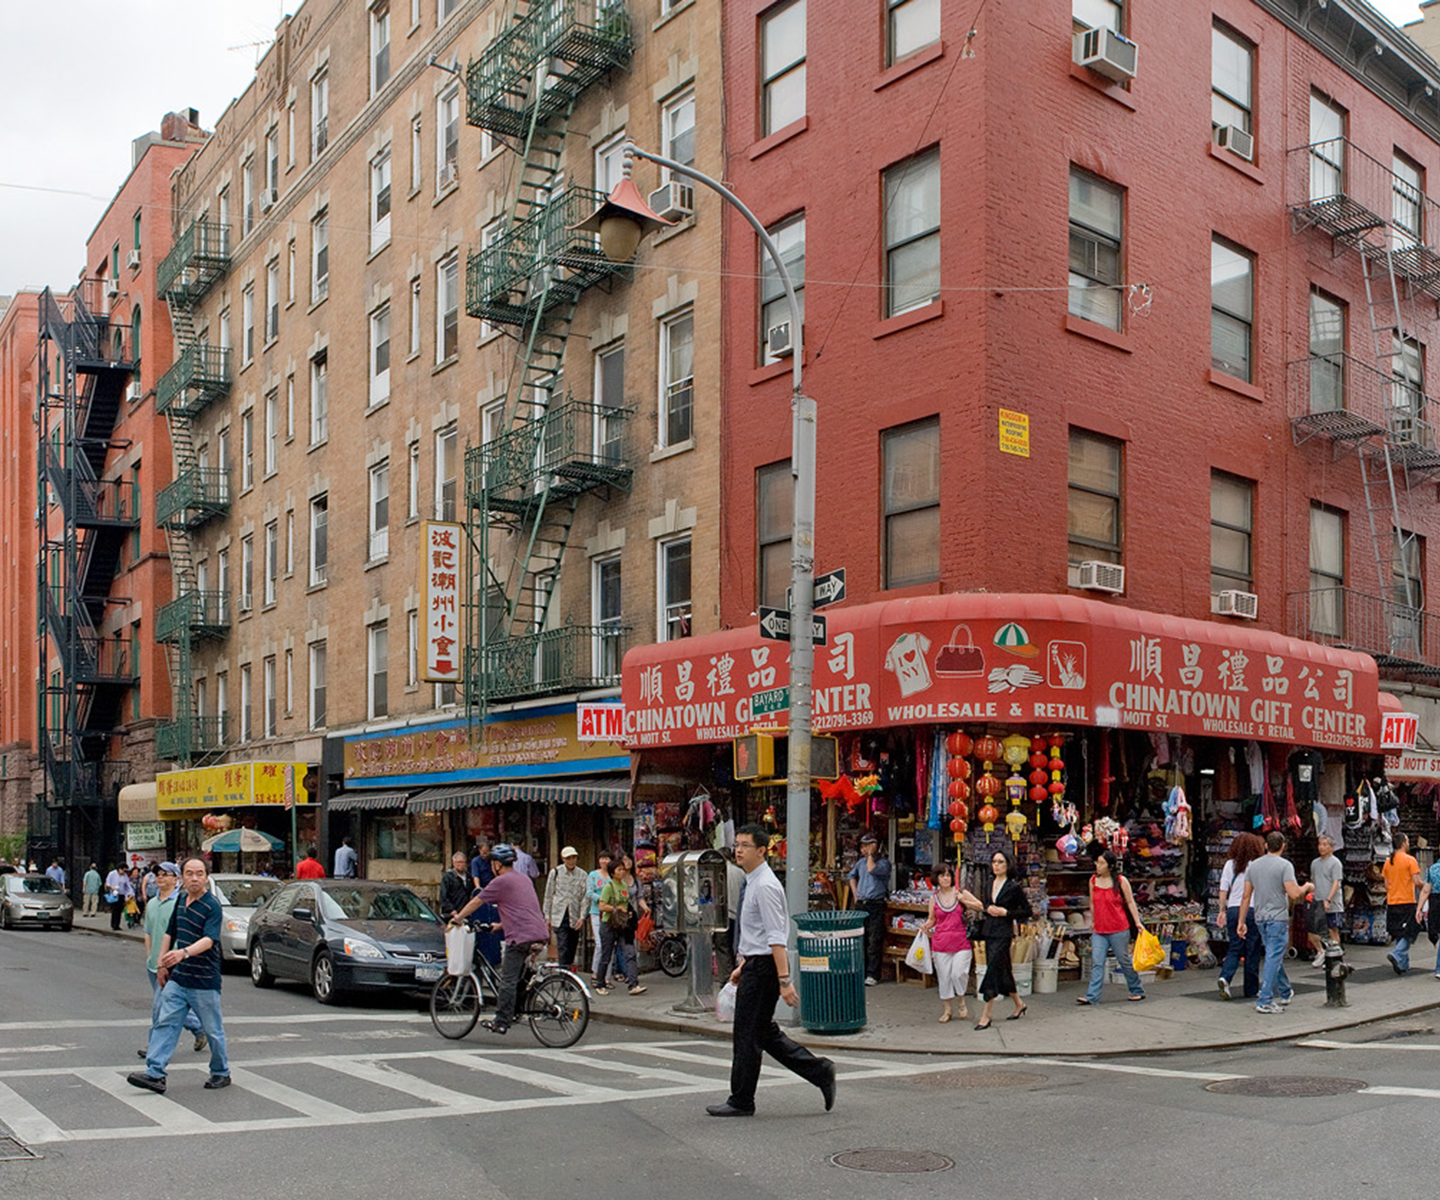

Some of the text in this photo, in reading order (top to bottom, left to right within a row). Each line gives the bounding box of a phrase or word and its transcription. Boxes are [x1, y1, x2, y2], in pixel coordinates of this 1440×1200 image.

[820, 580, 837, 597] WAY
[769, 618, 788, 632] ONE
[640, 632, 855, 705] 順昌禮品司
[754, 690, 783, 707] BAYARD
[626, 683, 871, 734] CHINATOWN NTER
[888, 702, 1089, 721] WHOLESALE & RETAIL
[1109, 682, 1367, 737] CHINATOWN GIFT CENTER
[581, 708, 623, 735] ATM
[1123, 711, 1169, 728] MOTT ST.
[696, 726, 740, 740] WHOLESALE
[1203, 718, 1296, 740] WHOLESALE & RETAIL
[1383, 717, 1417, 745] ATM
[640, 733, 659, 746] MOTT
[1403, 757, 1427, 771] MOTT
